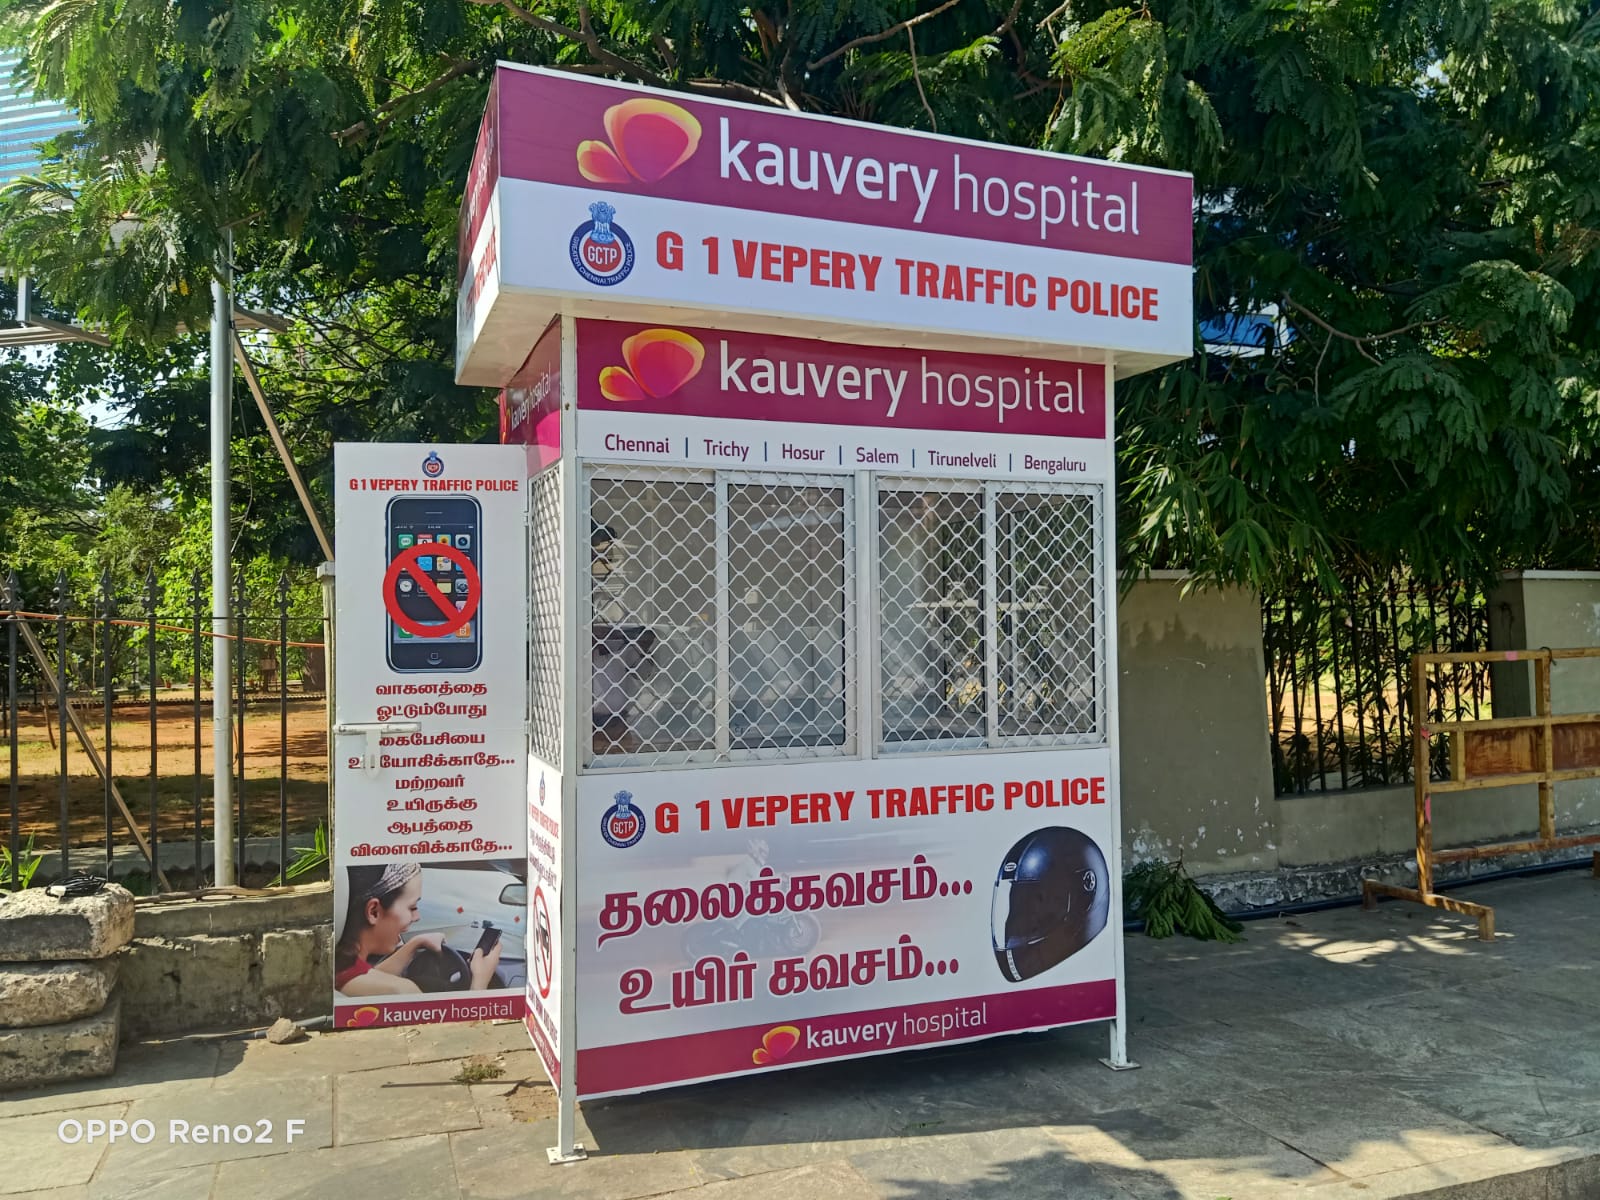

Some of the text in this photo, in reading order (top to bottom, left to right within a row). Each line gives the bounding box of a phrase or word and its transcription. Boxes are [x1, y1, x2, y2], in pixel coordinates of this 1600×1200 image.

[719, 117, 1140, 239] kauvery hospital
[587, 245, 618, 266] GCTP
[656, 230, 1158, 321] G 1 VEPERY TRAFFIC POLICE
[719, 339, 1086, 424] kauvery hospital
[604, 434, 1088, 474] Chennai Trichy Hosur Salem Tirunelveli Bengaluru
[349, 478, 519, 492] G 1 VEPERY TRAFFIC POLICE
[375, 680, 488, 697] வாகனத்தை
[376, 701, 487, 722] ஓட்டும்போது
[347, 751, 516, 769] உயோகிக்காதே...
[395, 773, 466, 791] மற்றவர்
[386, 796, 478, 813] உயிருக்கு
[655, 776, 1106, 834] G 1 VEPERY TRAFFIC POLICE
[386, 818, 473, 836] ஆபத்தை
[613, 821, 634, 834] GCTP
[597, 854, 973, 951] தலைக்கவசம்...
[618, 951, 758, 1014] உயிர்
[768, 934, 960, 998] கவசம்...
[383, 999, 513, 1023] kauvery hospital
[806, 1002, 988, 1049] kauvery hospital
